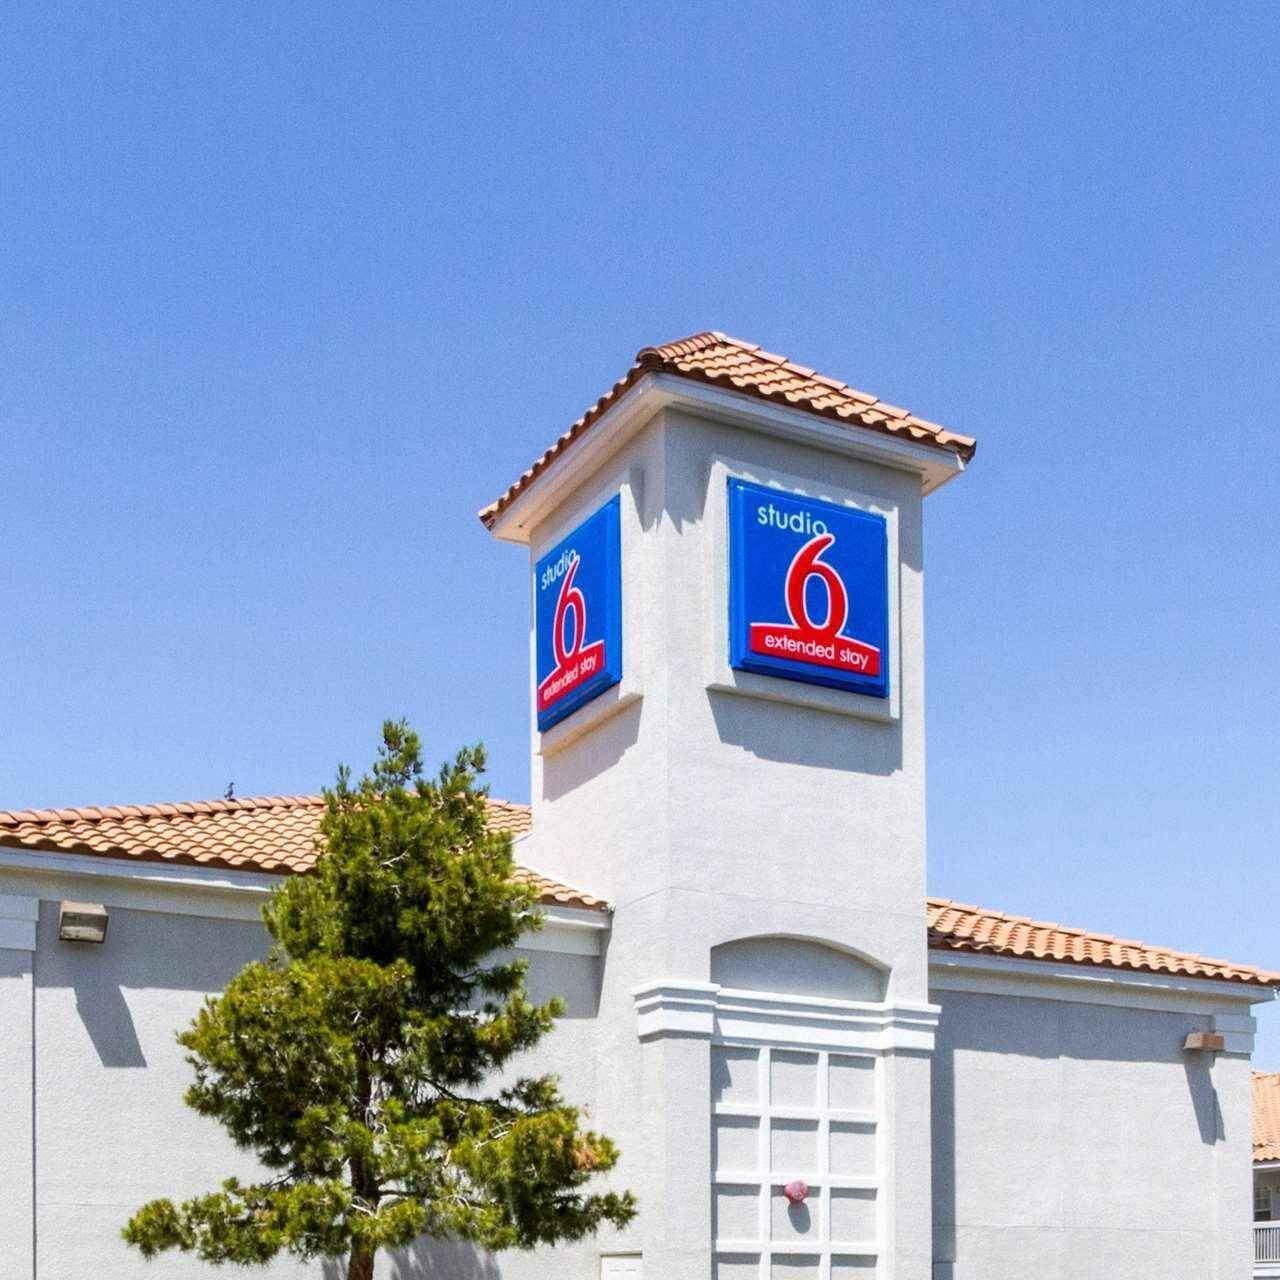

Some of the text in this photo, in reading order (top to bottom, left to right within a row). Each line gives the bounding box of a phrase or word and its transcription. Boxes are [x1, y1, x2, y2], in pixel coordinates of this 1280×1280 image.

[758, 504, 827, 535] studio
[542, 549, 576, 590] studio
[785, 533, 848, 638] 6
[553, 555, 586, 668] 6
[765, 635, 869, 670] extended stay
[544, 655, 597, 701] extended stay
